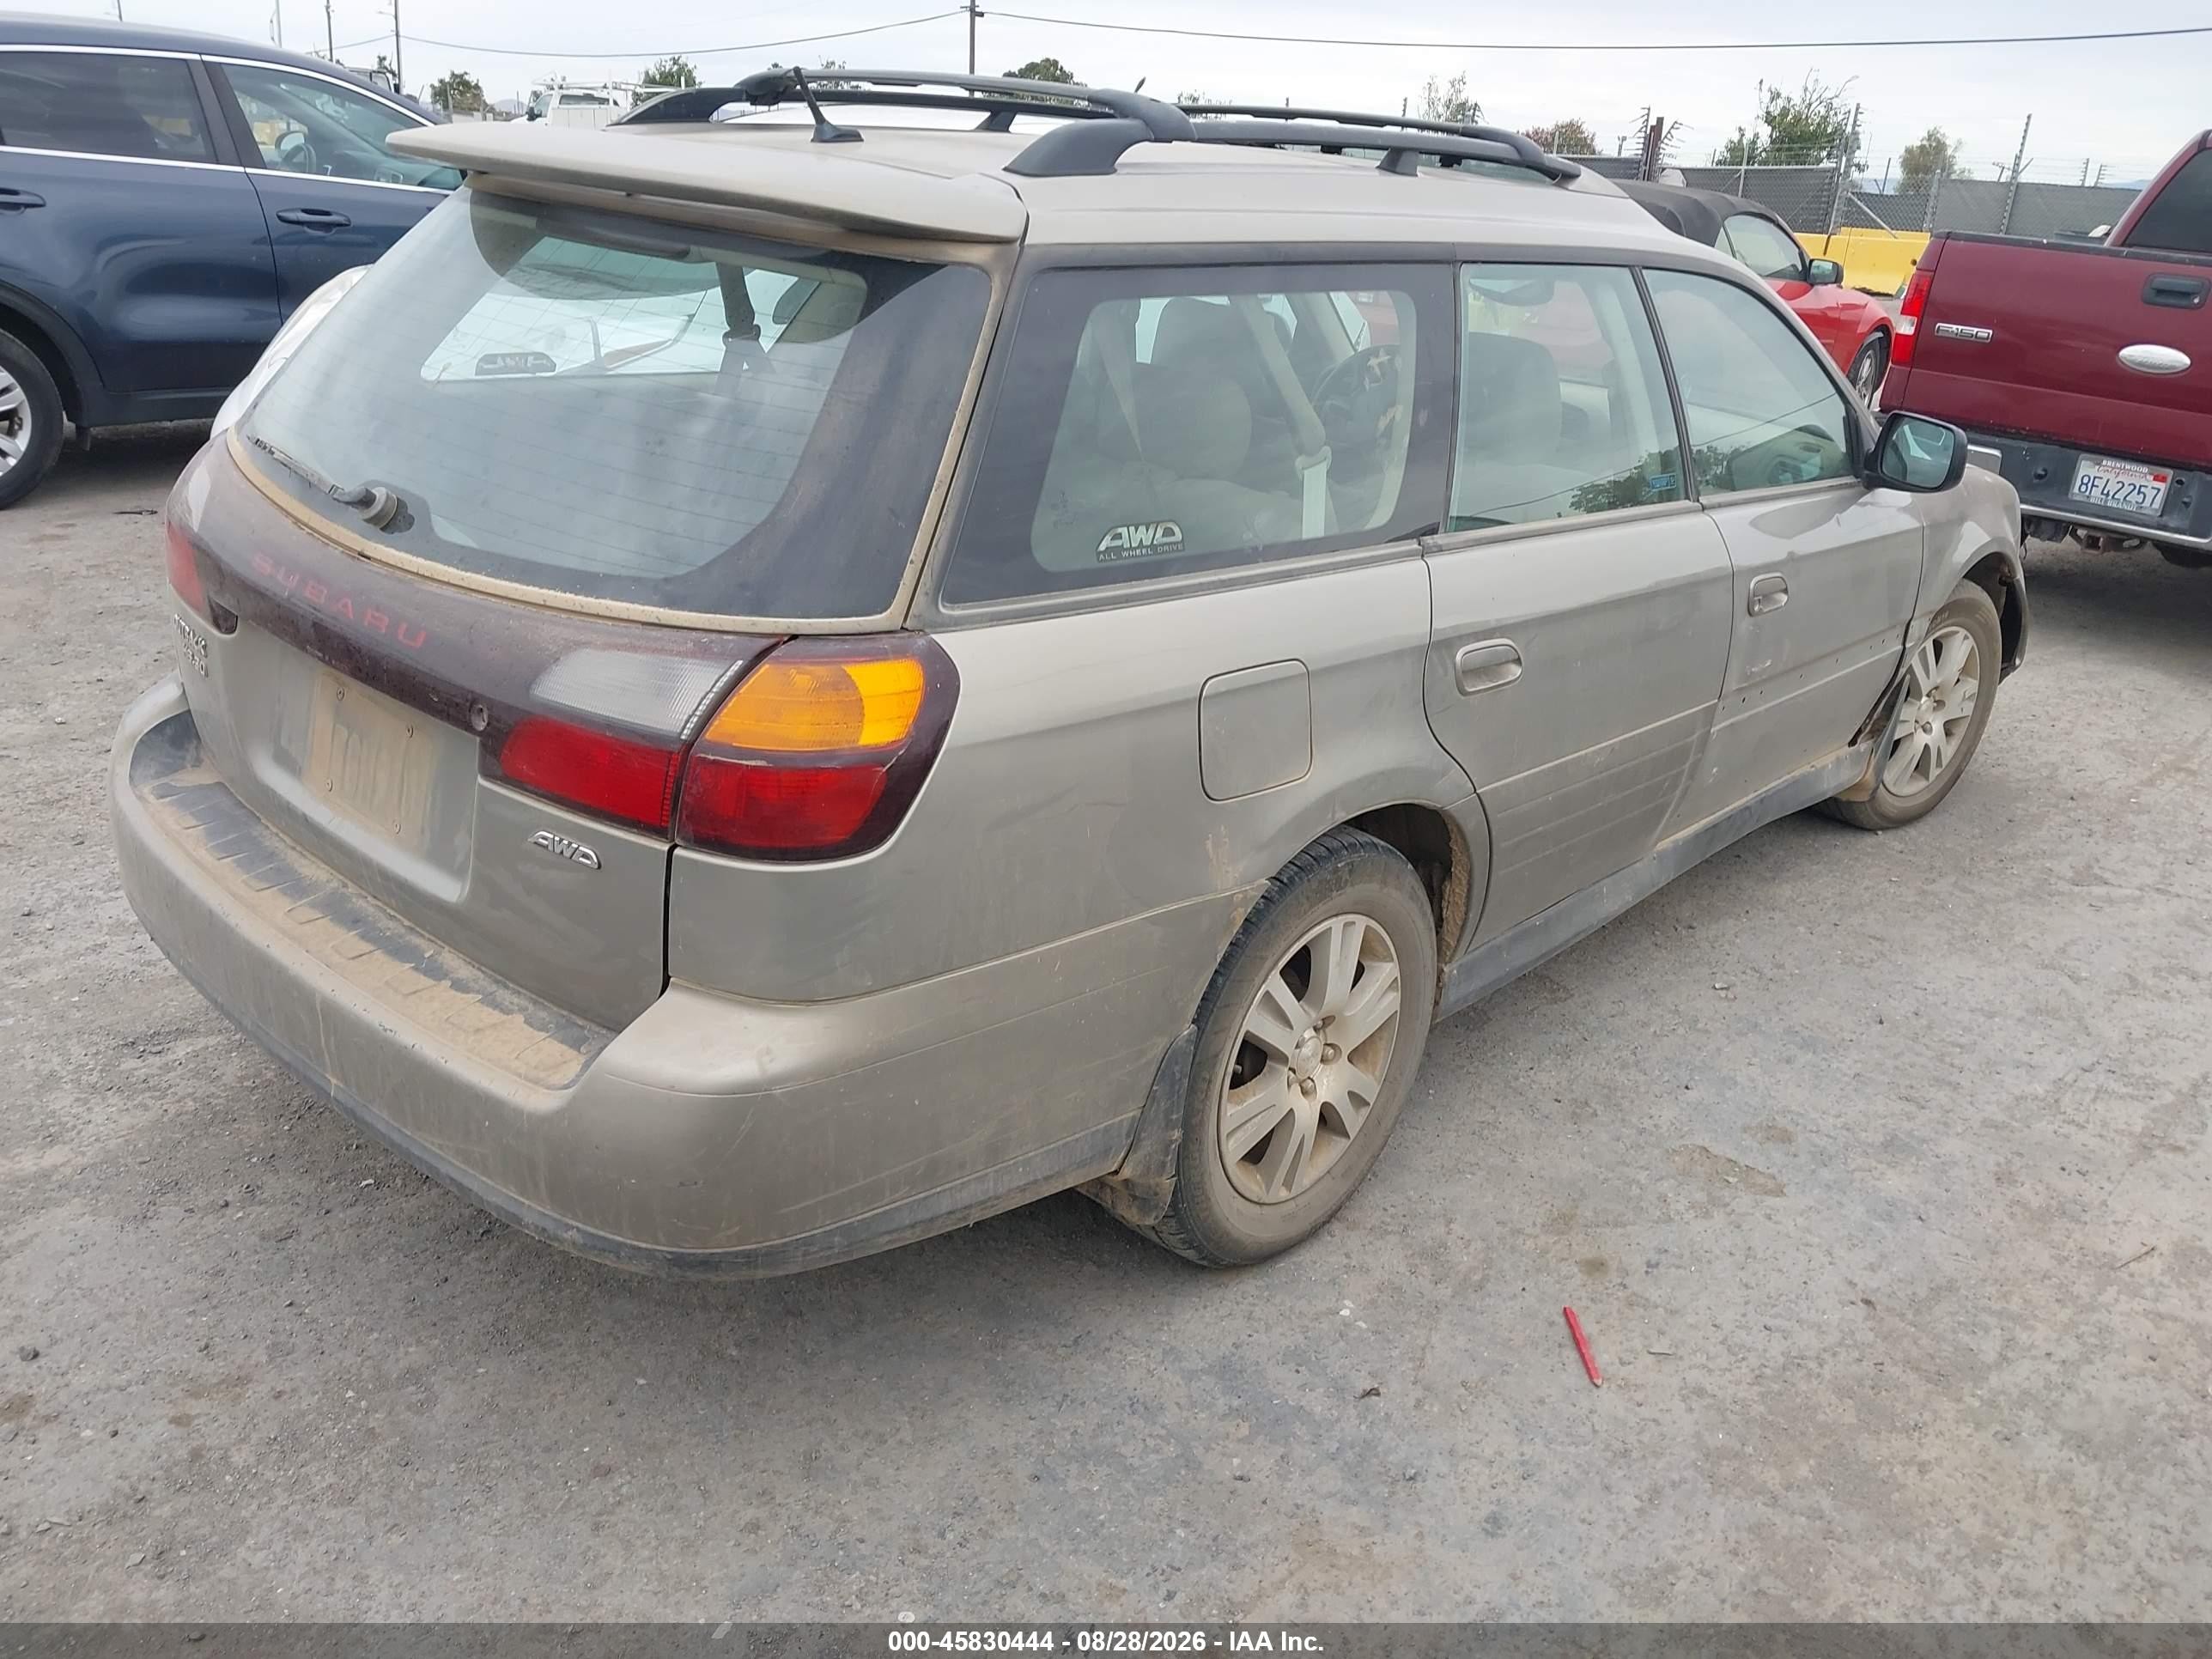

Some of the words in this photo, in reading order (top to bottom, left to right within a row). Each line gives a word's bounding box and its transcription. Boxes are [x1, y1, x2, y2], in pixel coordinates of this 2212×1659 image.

[2101, 459, 2149, 473] BRENTWOOD
[2078, 474, 2161, 507] 8F42257
[1097, 521, 1183, 551] AWD
[1099, 552, 1117, 562] ALL
[1121, 548, 1154, 558] WHEEL
[1158, 544, 1183, 553] DRIVE
[251, 552, 428, 651] SUBARU
[527, 830, 601, 870] AWD
